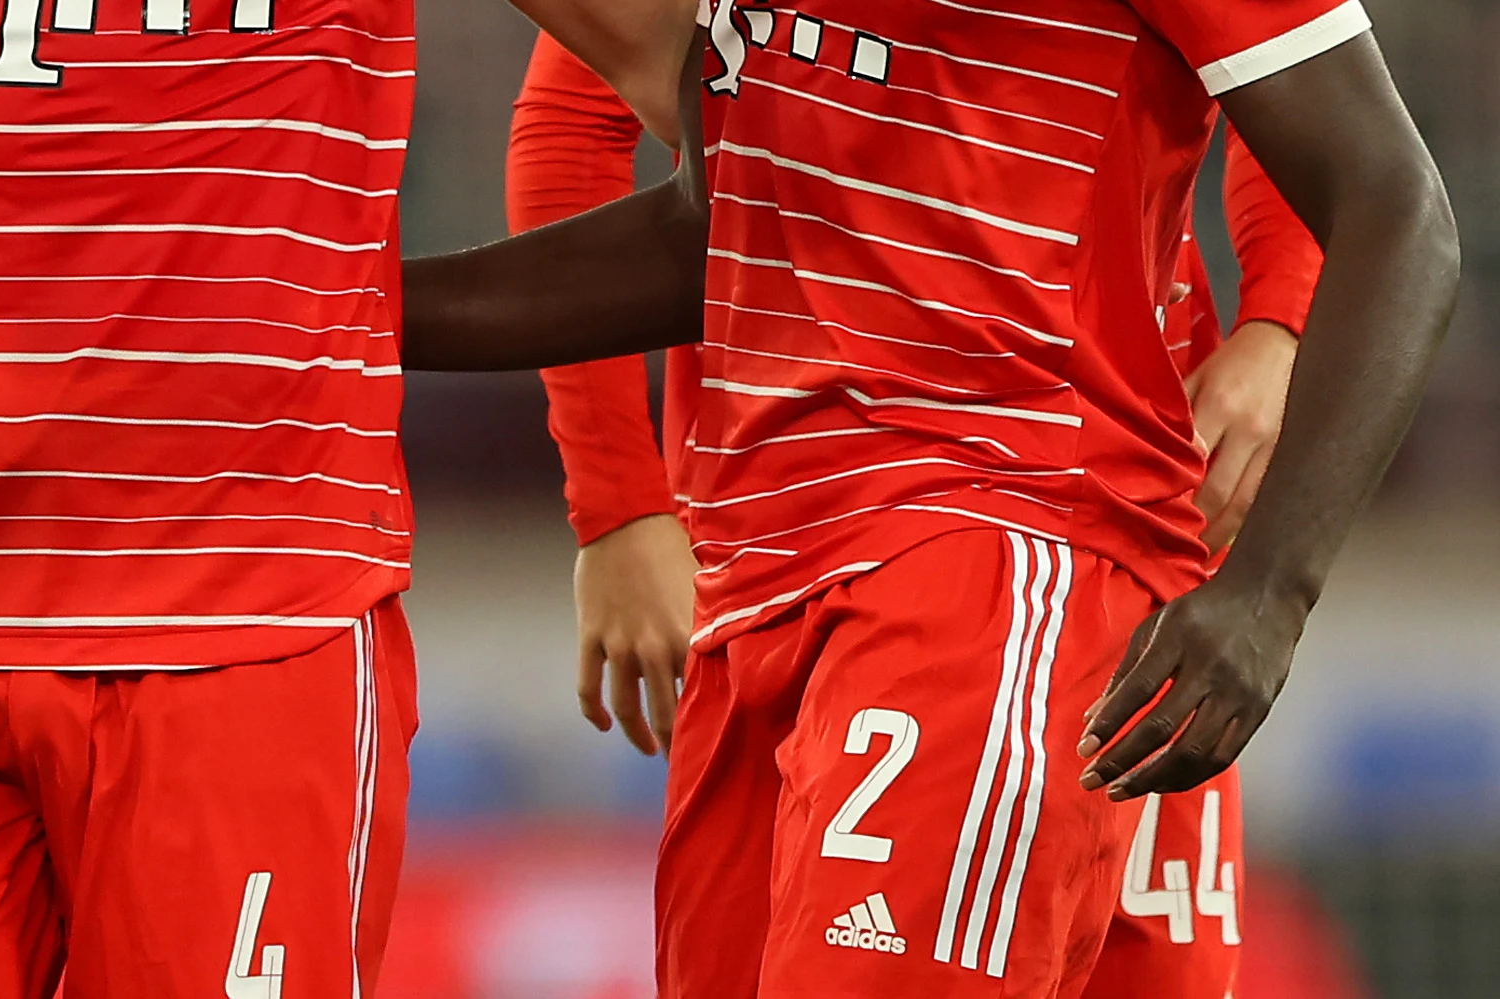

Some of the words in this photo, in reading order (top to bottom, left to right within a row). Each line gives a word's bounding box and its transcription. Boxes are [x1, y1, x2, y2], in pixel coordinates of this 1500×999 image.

[821, 708, 920, 862] 2
[225, 871, 285, 999] 4
[1120, 790, 1242, 945] 44
[825, 925, 906, 955] adidas
